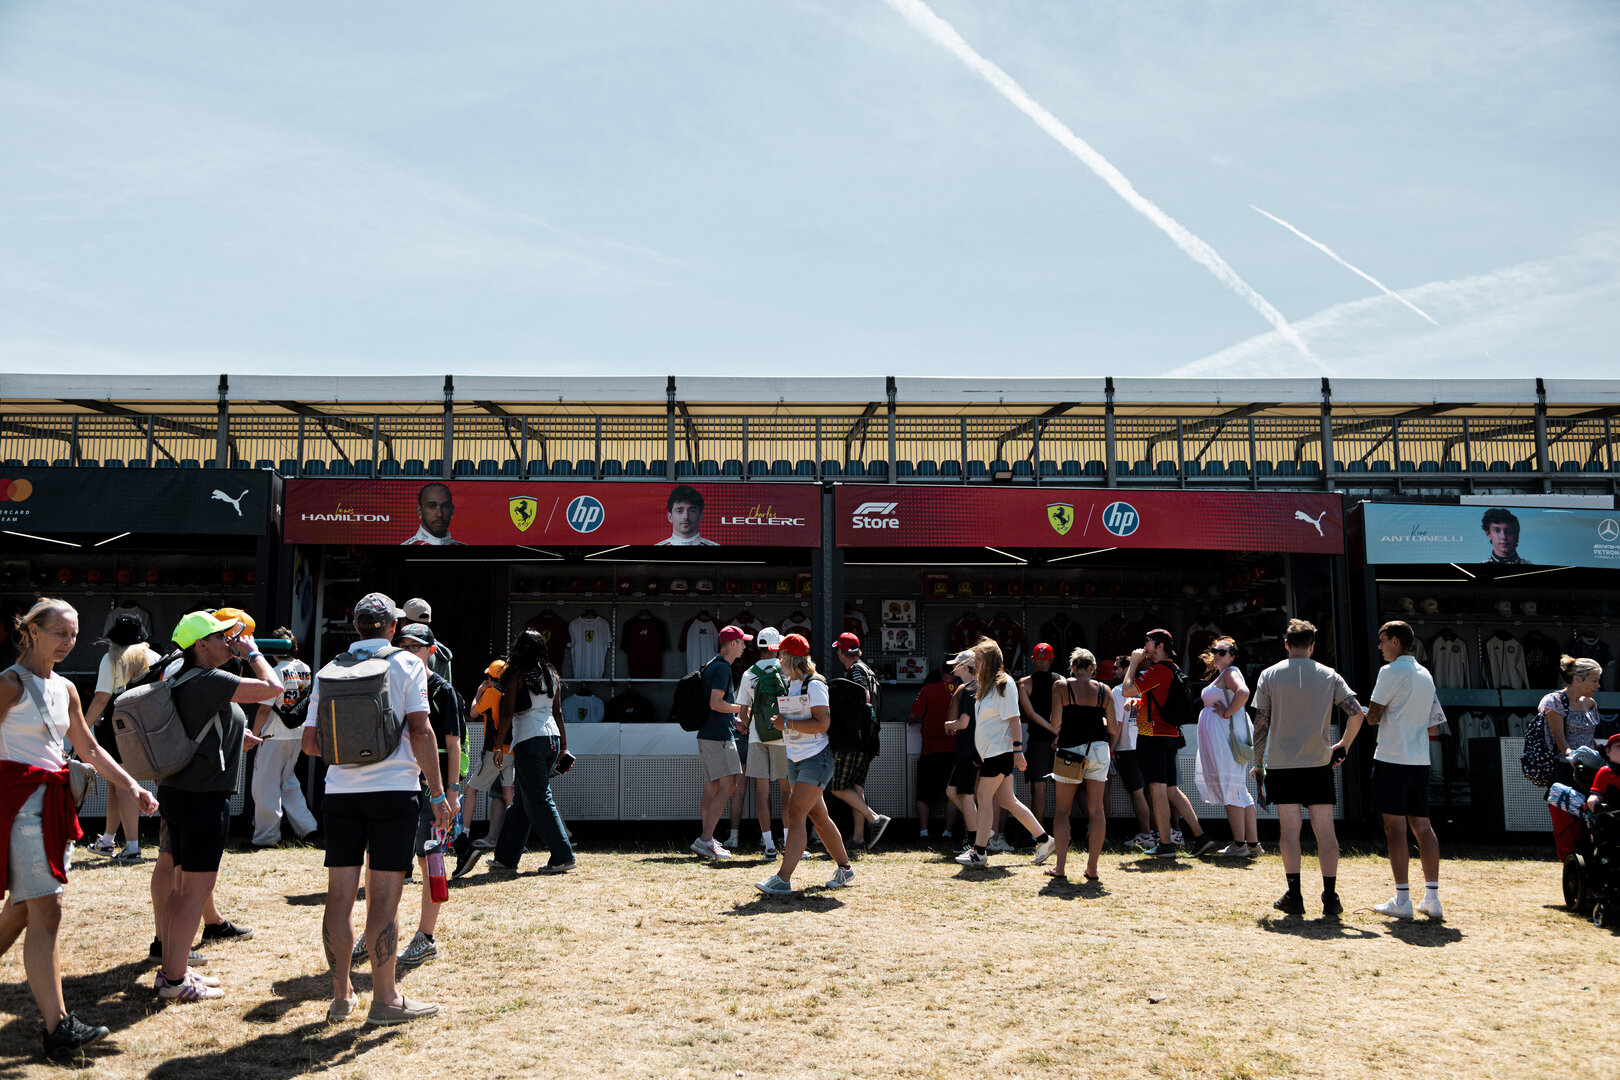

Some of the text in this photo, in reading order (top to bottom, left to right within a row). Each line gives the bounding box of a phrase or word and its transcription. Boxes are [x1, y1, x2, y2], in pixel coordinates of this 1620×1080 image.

[301, 513, 390, 522] HAMILTON
[571, 496, 600, 532] hp
[748, 503, 777, 519] Charles
[721, 516, 806, 527] LECLERC
[852, 516, 899, 529] Store
[1108, 501, 1135, 536] hp
[1380, 535, 1464, 543] ANTONELLI
